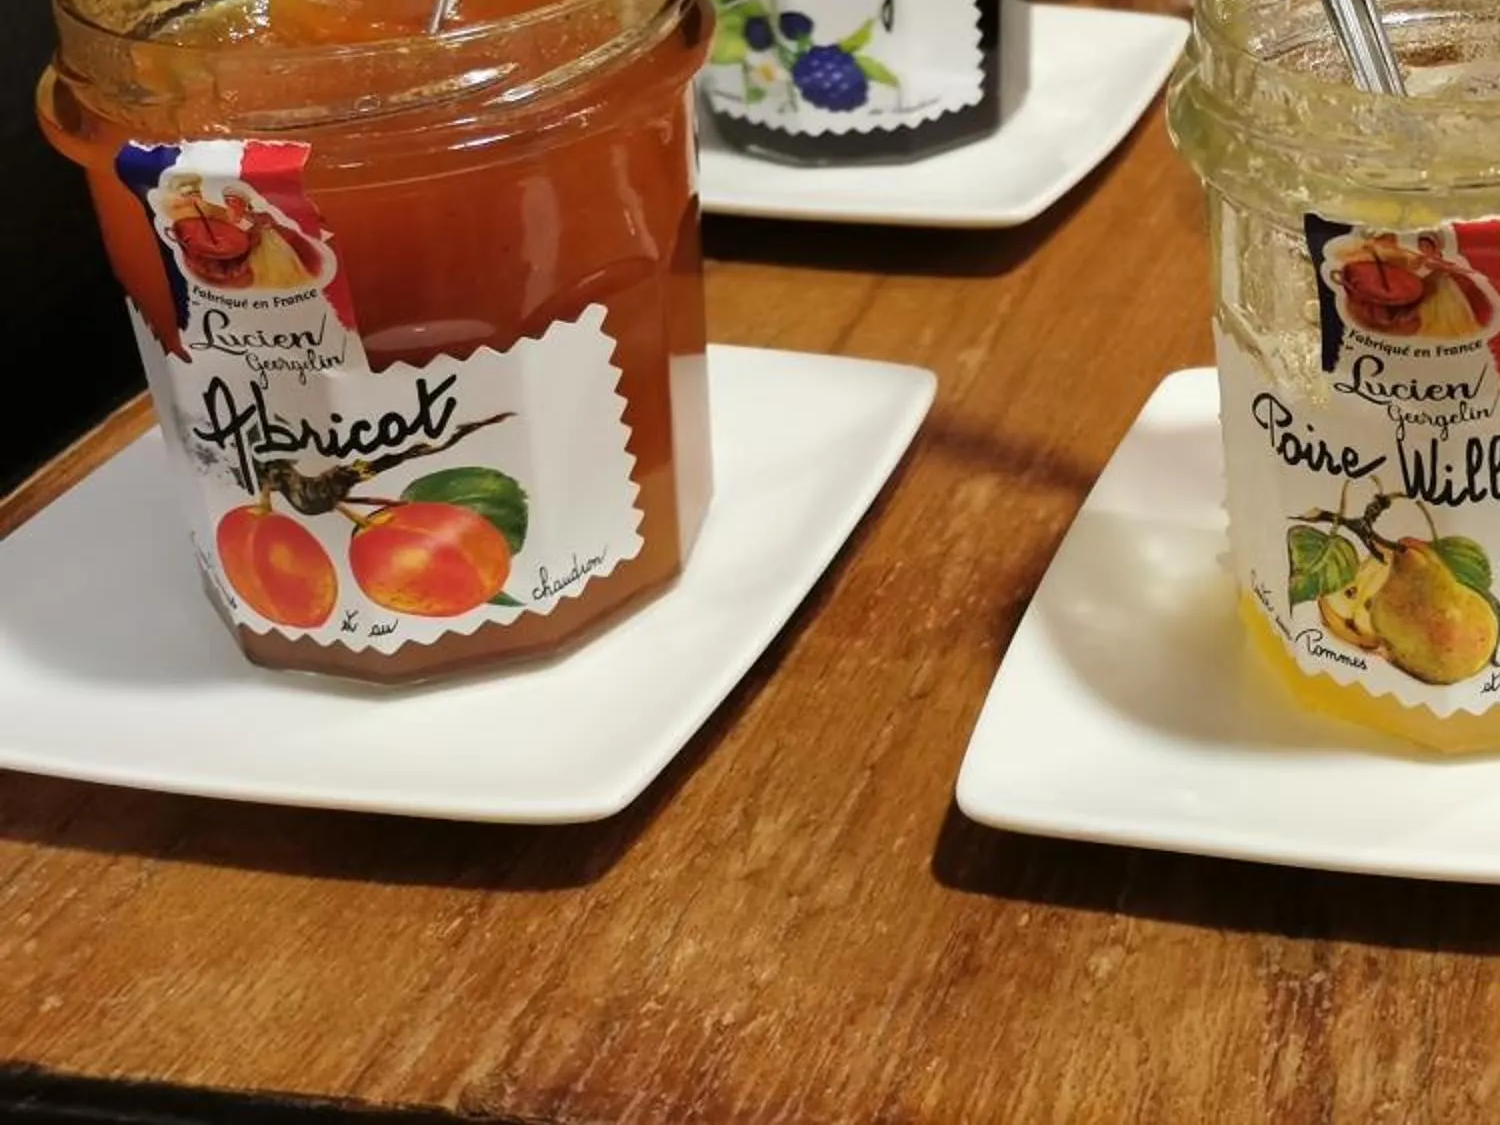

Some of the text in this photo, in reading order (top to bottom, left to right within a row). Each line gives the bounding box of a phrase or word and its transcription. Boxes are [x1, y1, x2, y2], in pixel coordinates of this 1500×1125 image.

[193, 285, 318, 309] Fabriqué en France
[190, 308, 328, 355] Lucien
[1349, 329, 1483, 358] Fabriqué en France
[1333, 355, 1488, 405] Lucien
[193, 375, 457, 495] Abricot
[1252, 392, 1387, 477] Poire
[532, 544, 607, 601] chaudron
[1294, 628, 1368, 671] Pommes
